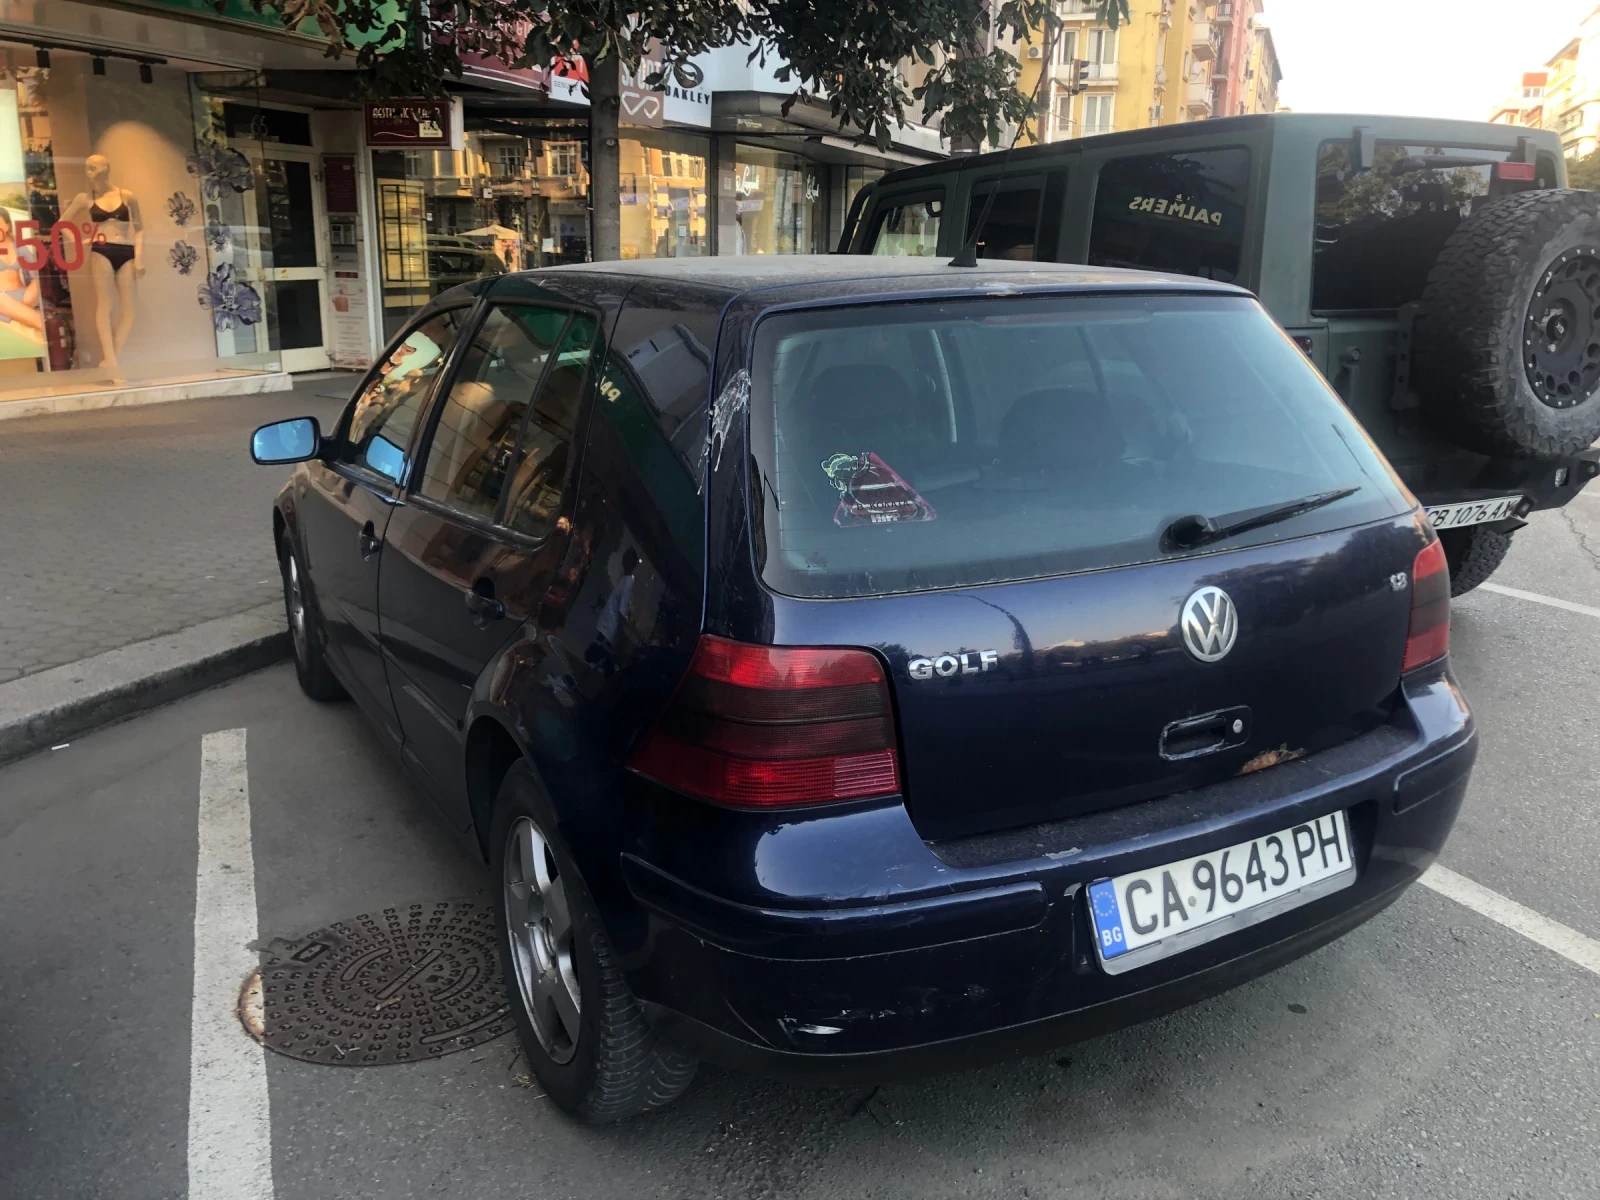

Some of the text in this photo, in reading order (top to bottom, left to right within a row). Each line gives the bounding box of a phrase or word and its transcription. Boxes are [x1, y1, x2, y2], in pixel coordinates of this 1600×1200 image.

[664, 86, 710, 105] OAKLEY
[908, 650, 998, 680] GOLF
[1125, 814, 1344, 936] CA 9643 PH
[1101, 926, 1124, 947] BG
